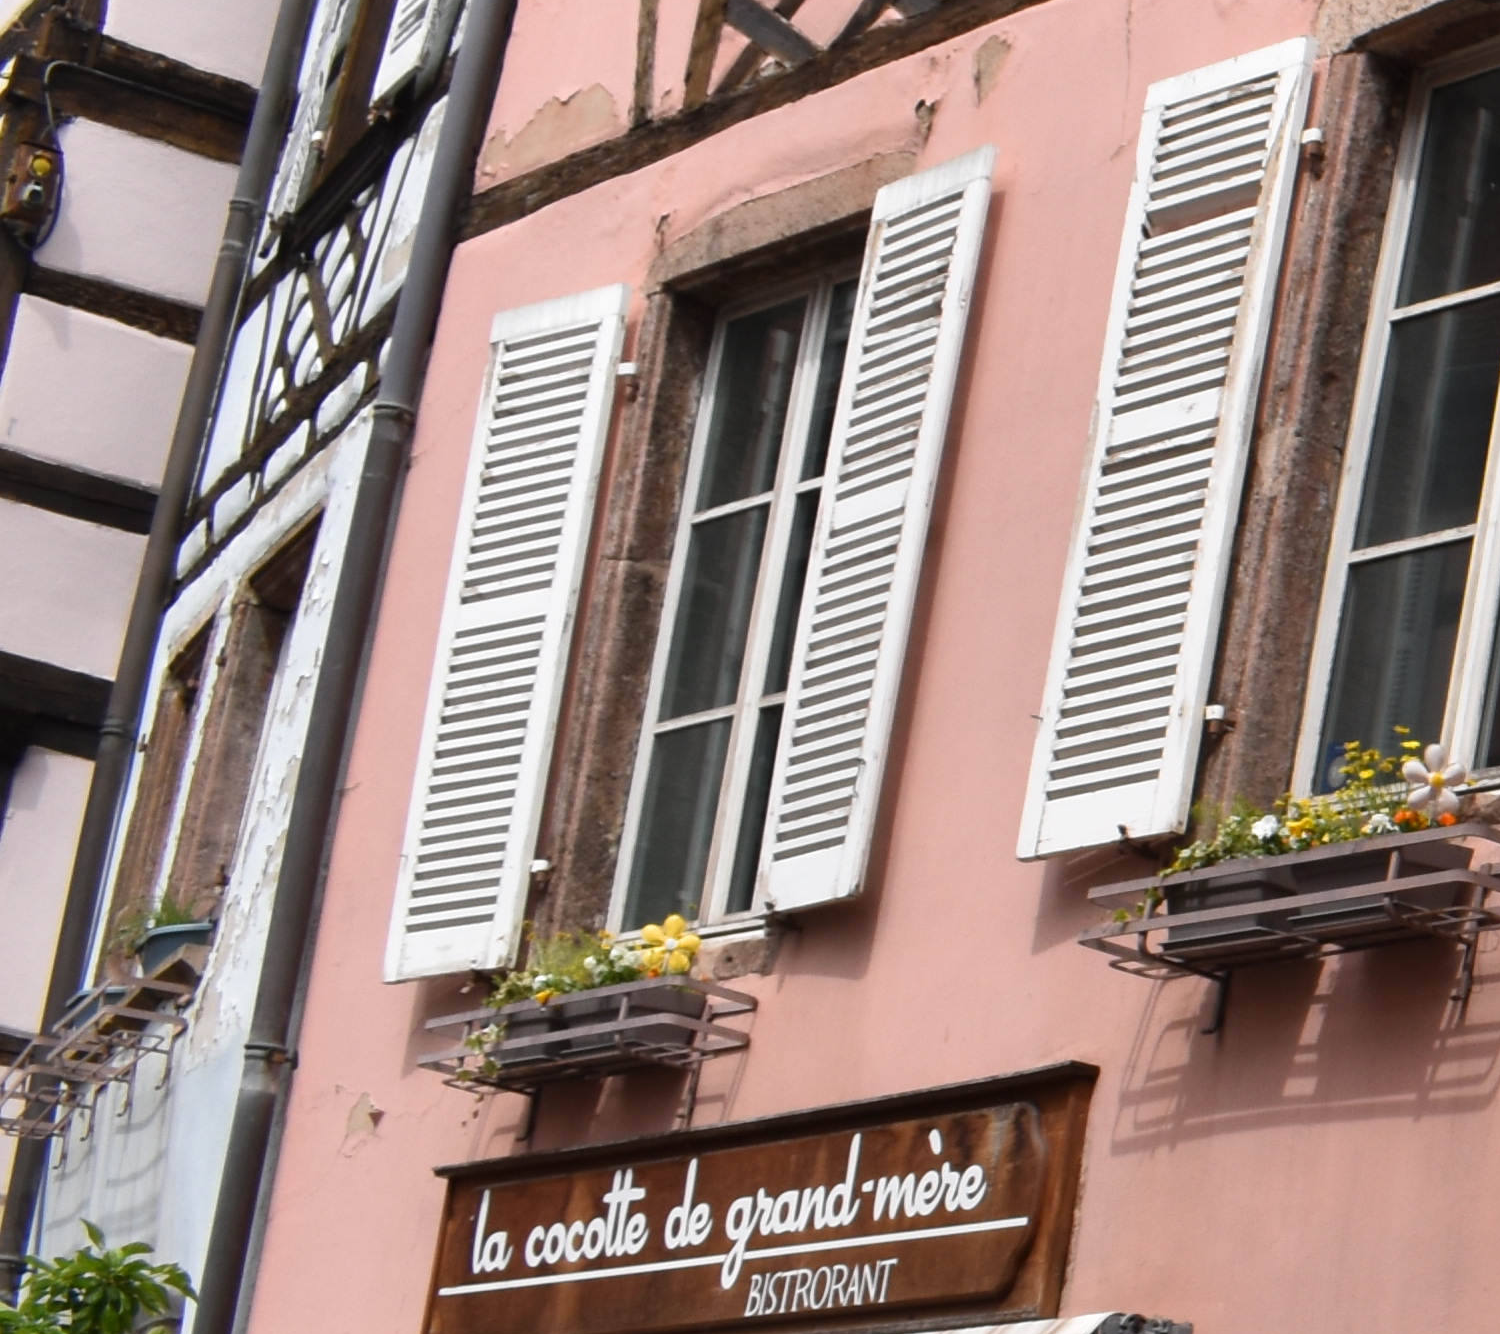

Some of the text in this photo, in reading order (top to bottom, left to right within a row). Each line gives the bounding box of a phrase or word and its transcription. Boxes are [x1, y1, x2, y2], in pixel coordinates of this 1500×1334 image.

[472, 1128, 986, 1289] la cocotte de grand-mère
[744, 1257, 898, 1317] BISTRORANT
